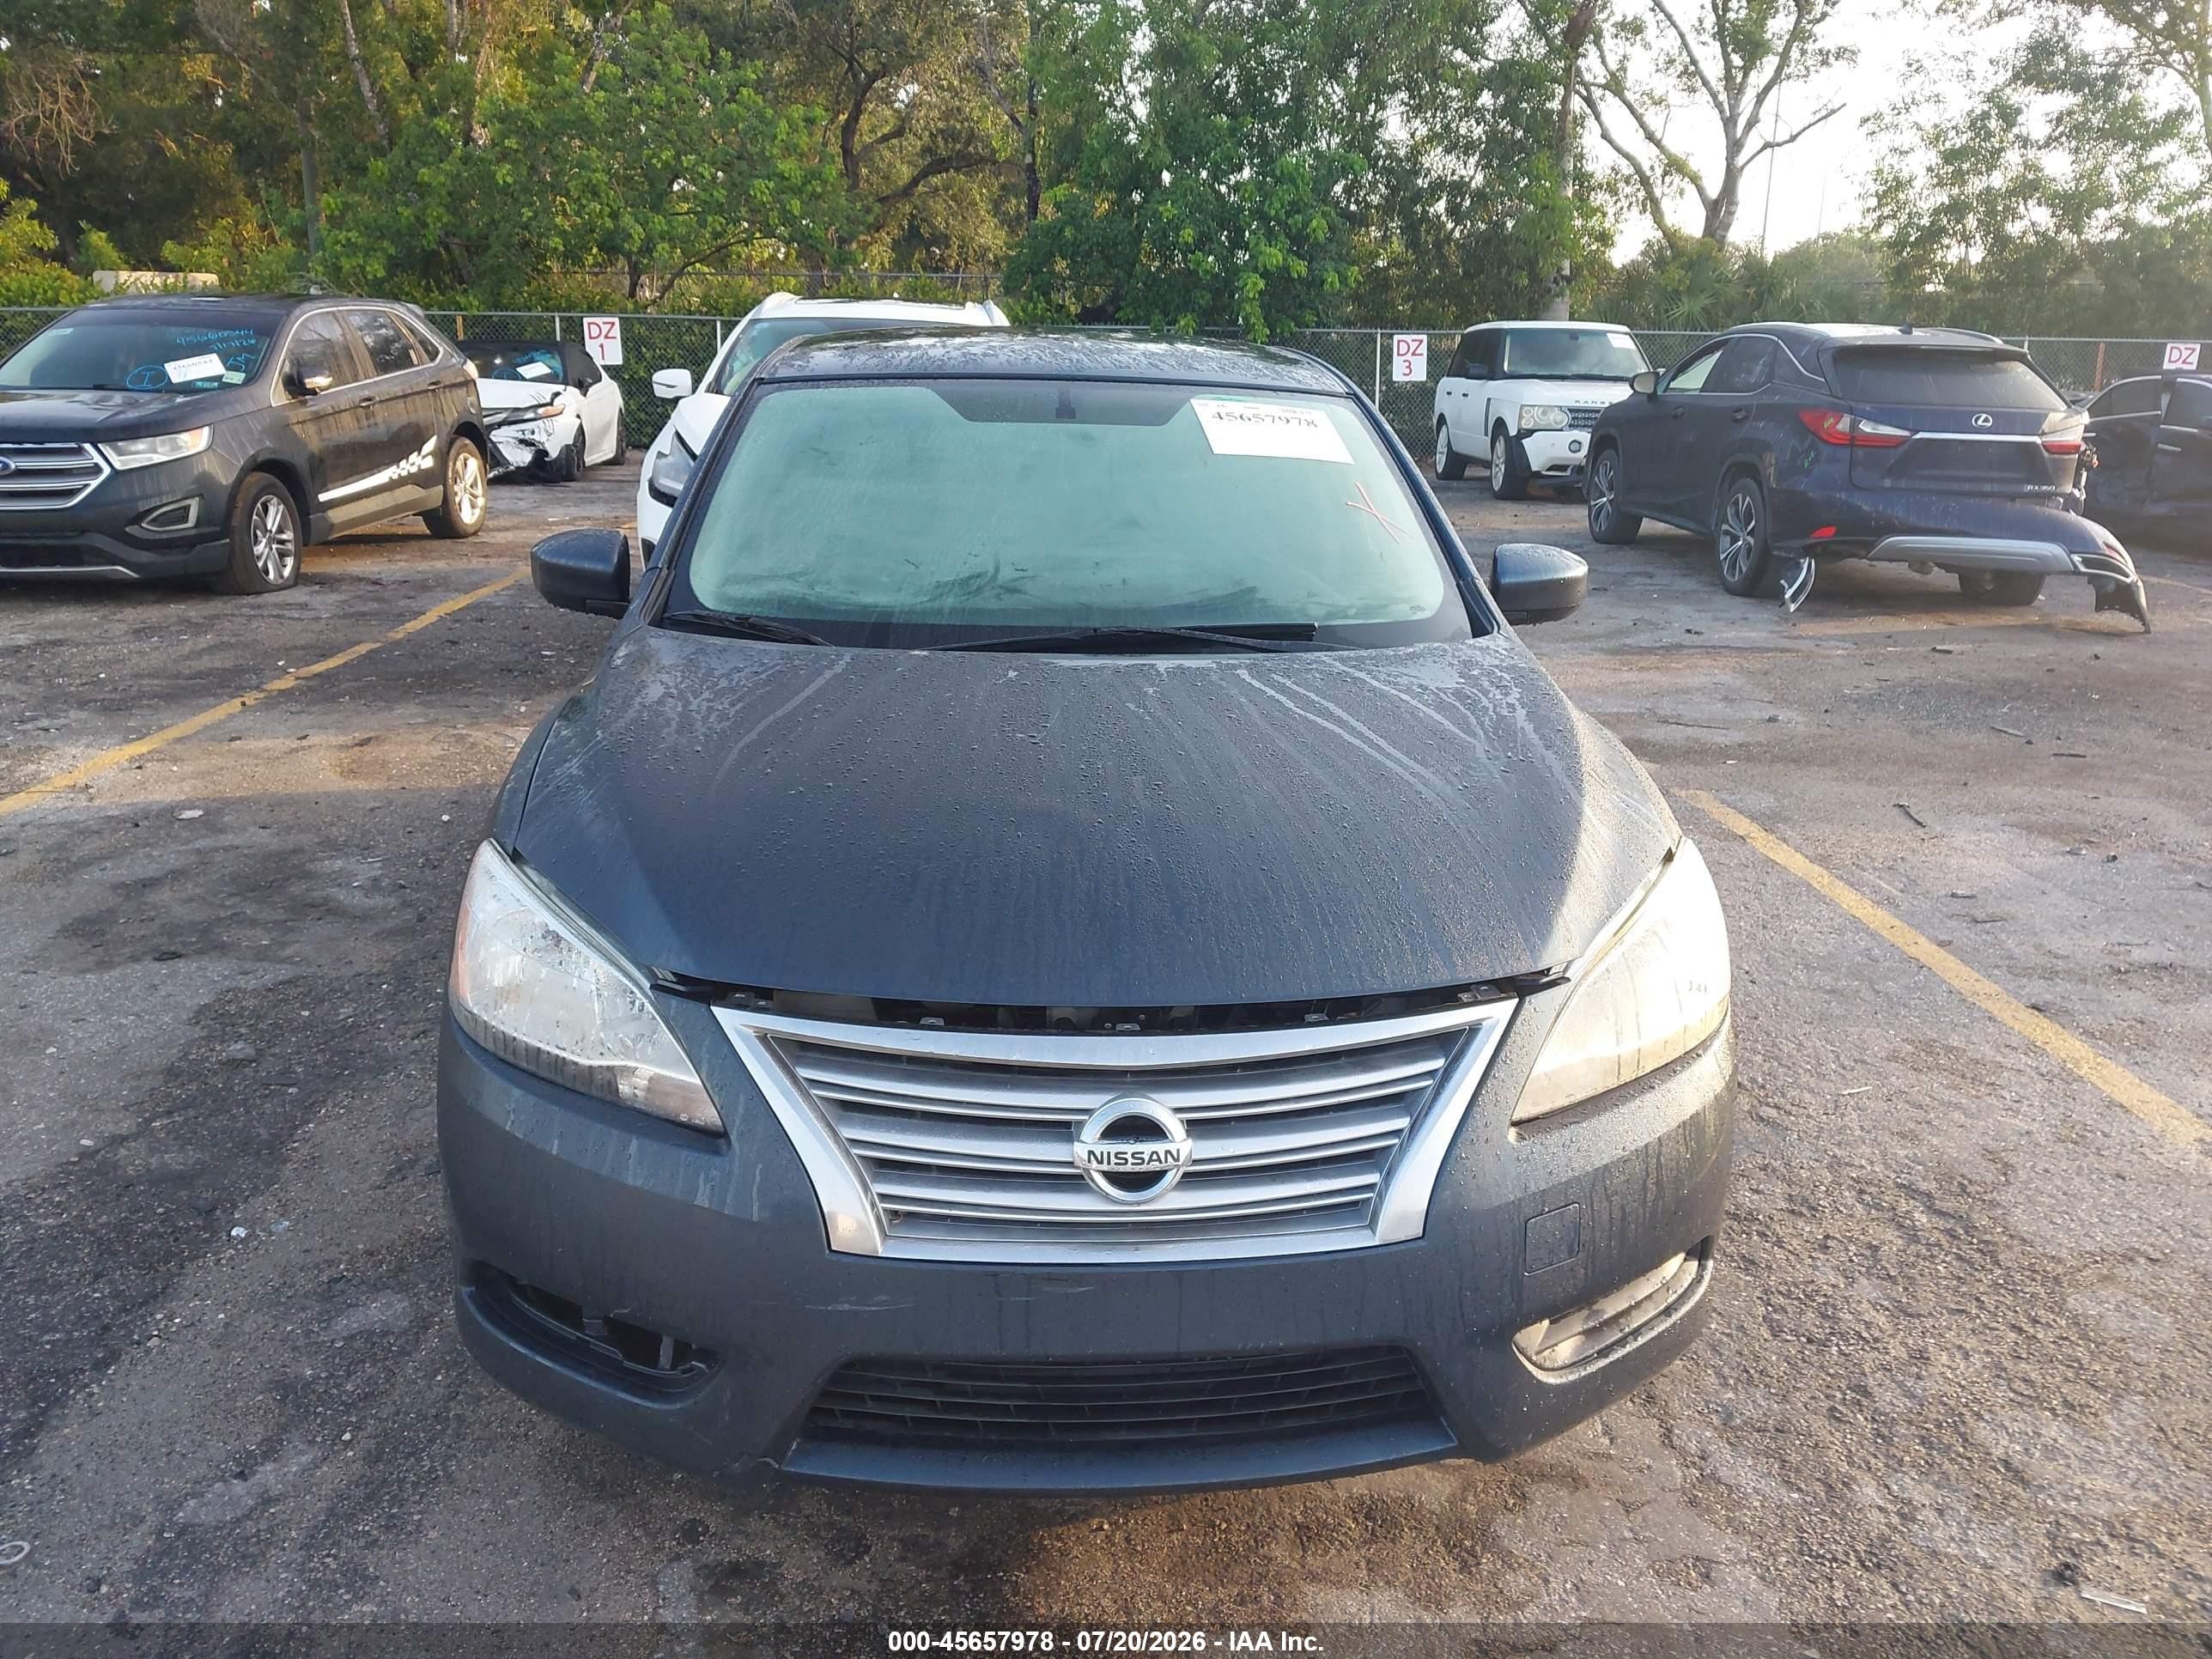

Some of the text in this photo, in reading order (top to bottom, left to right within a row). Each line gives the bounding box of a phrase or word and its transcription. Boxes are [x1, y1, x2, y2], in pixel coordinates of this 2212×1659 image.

[587, 321, 617, 340] DZ
[599, 343, 605, 361] 1
[1396, 339, 1424, 357] DZ
[2167, 345, 2197, 365] DZ
[1402, 360, 1413, 376] 3
[1087, 1148, 1180, 1166] NISSAN
